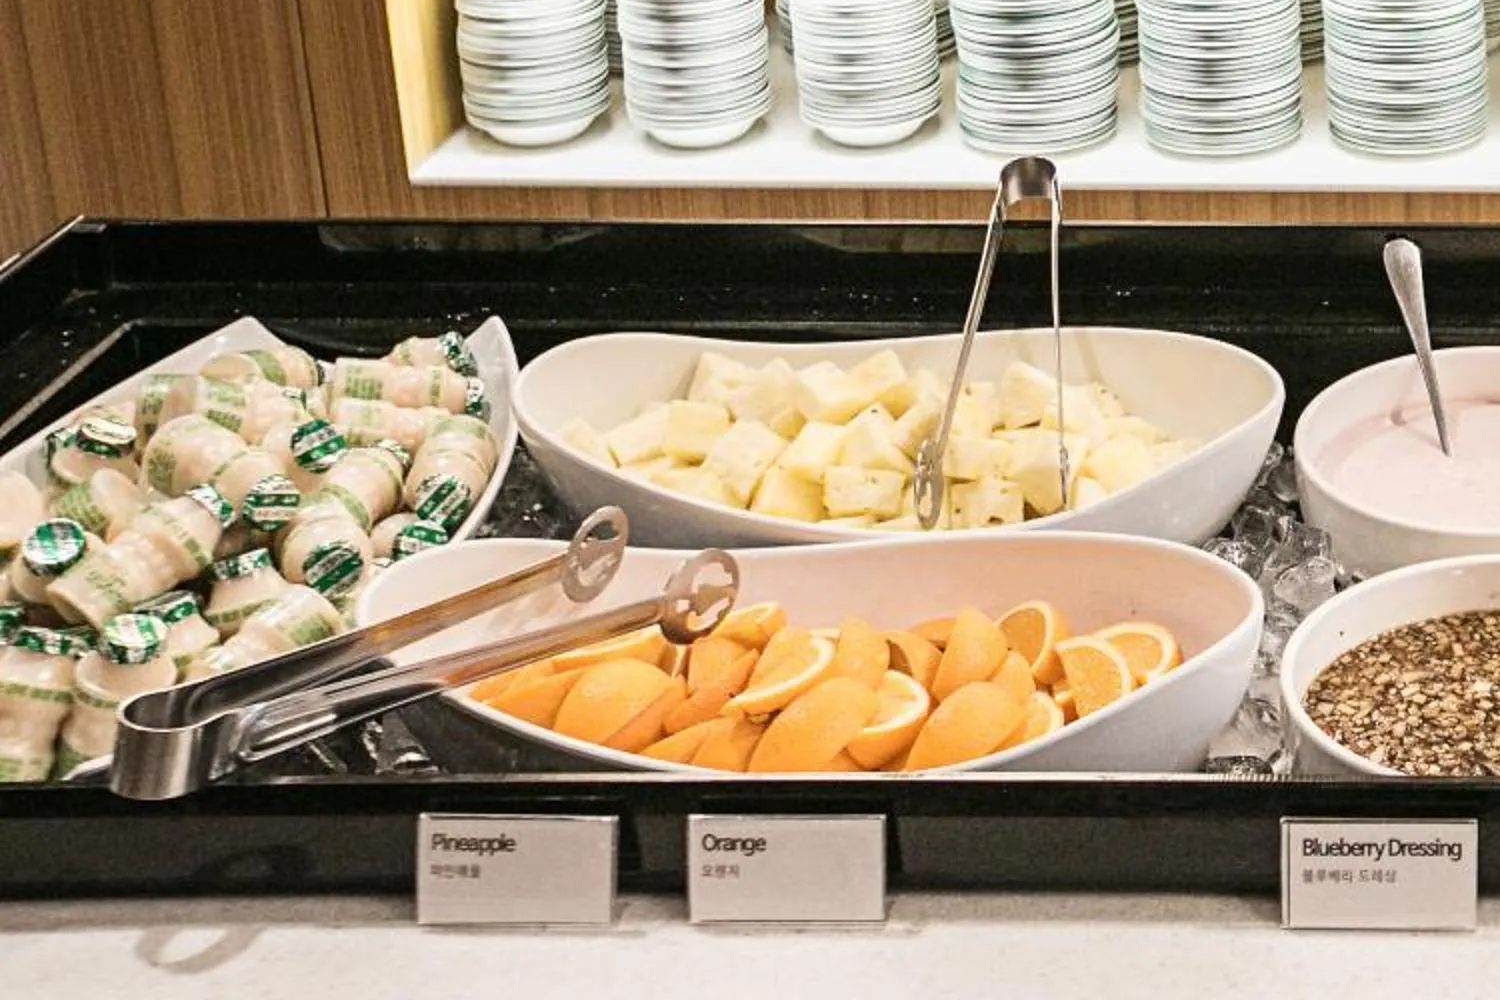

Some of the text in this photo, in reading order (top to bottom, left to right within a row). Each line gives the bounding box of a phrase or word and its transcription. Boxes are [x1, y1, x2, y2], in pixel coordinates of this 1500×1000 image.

[431, 833, 518, 856] Pineapple
[702, 833, 767, 857] Orange
[1302, 837, 1463, 861] Blueberry Dressing
[701, 864, 741, 879] 오렌지
[1302, 868, 1397, 883] 블루베리 드레싱
